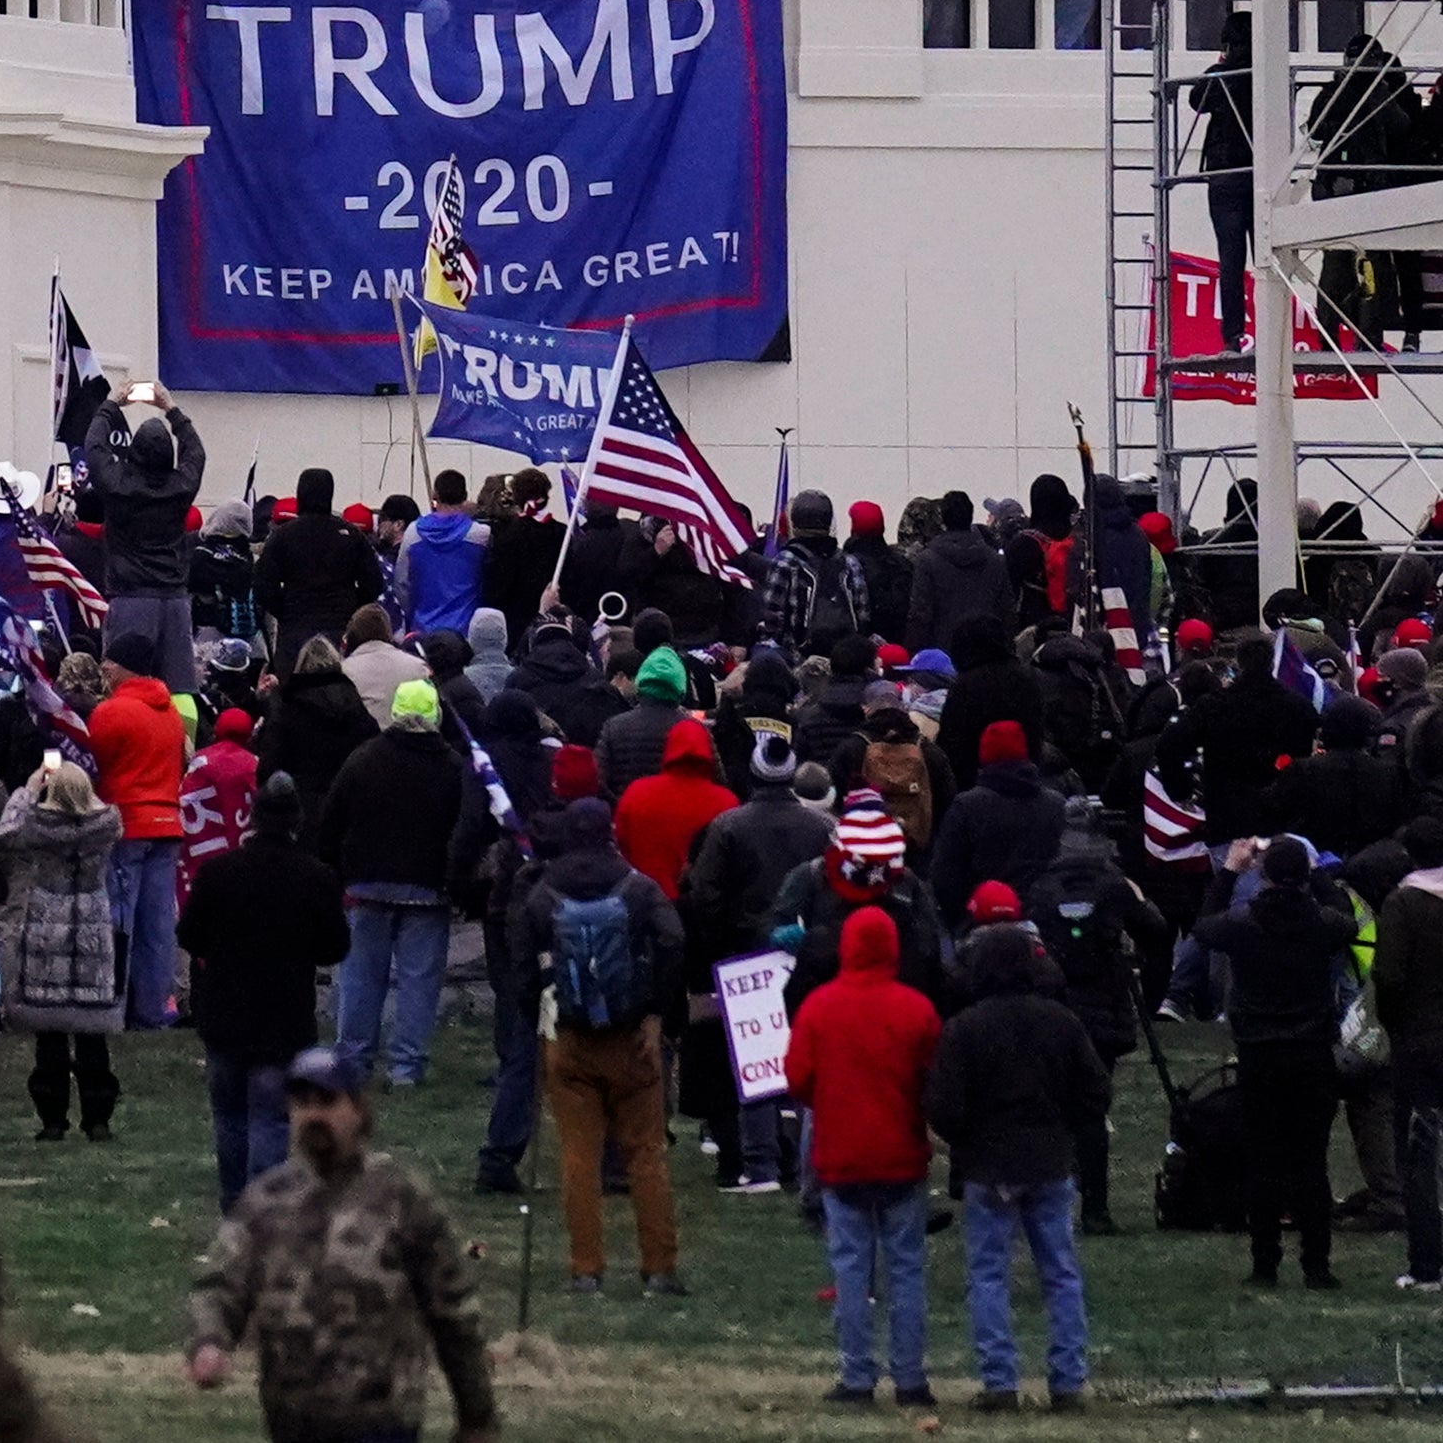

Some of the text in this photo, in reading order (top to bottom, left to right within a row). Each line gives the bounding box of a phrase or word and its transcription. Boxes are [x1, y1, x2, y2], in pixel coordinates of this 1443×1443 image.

[223, 232, 740, 300] KEEP AMICA GREAT!
[537, 413, 586, 432] GREAT
[724, 969, 774, 997] KEEP
[735, 1018, 762, 1039] TO
